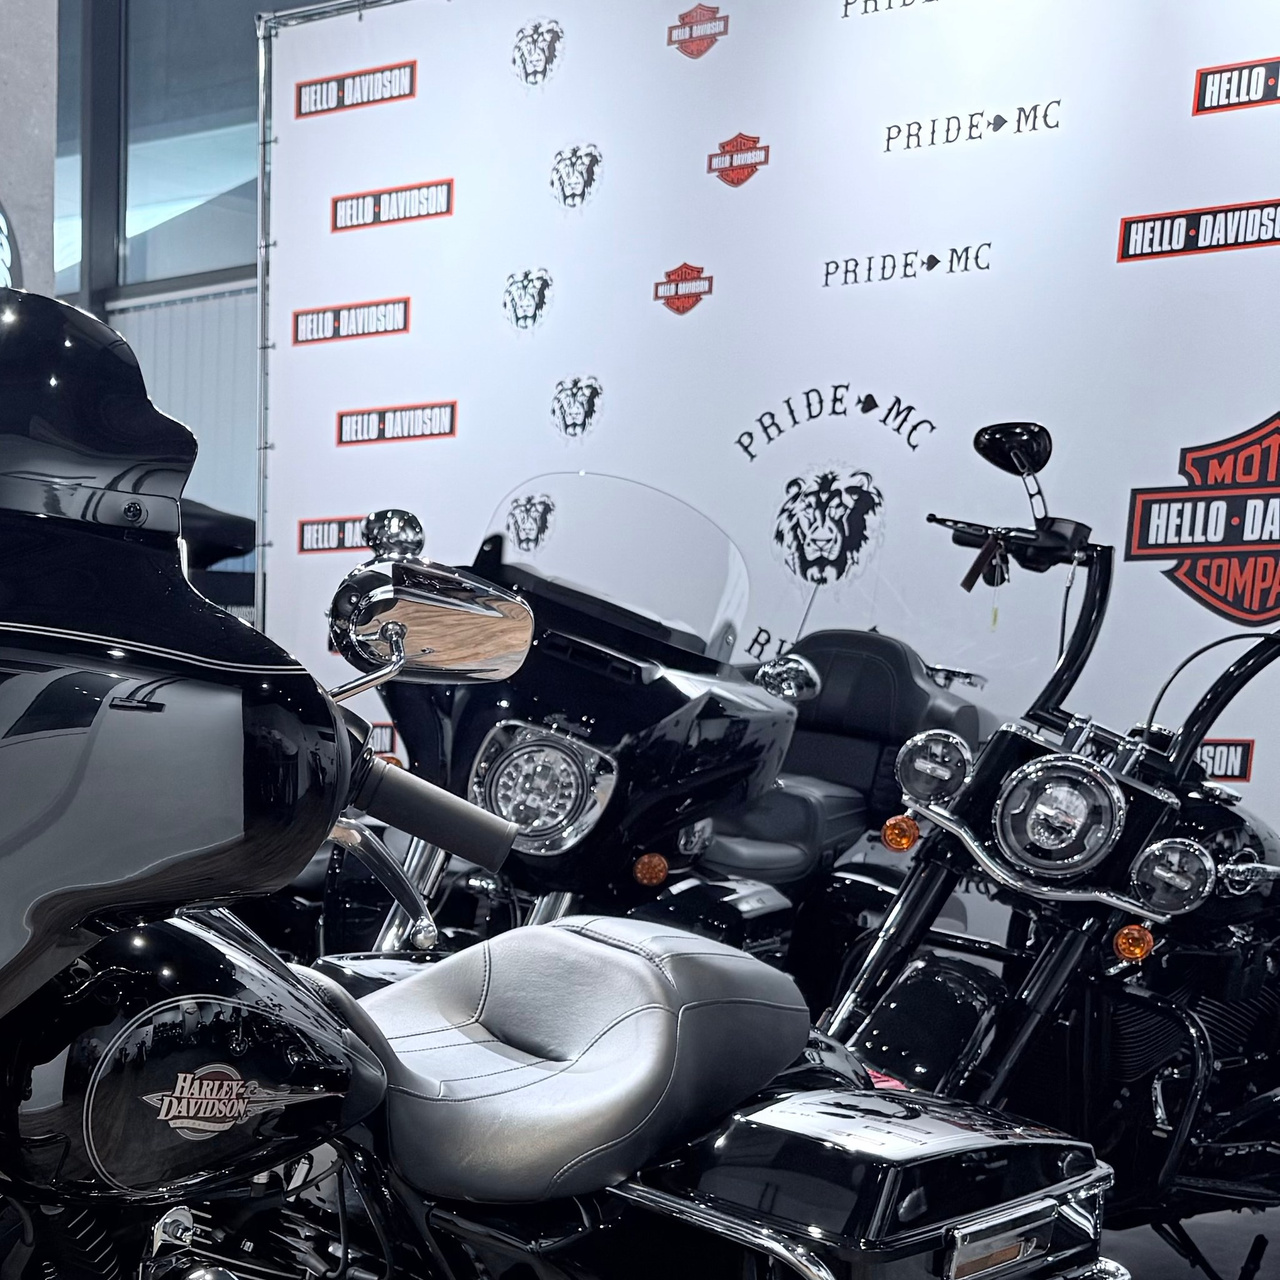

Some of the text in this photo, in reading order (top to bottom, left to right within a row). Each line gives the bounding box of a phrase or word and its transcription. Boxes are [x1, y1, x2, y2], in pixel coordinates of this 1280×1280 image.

[301, 66, 411, 113] HELLO DAVIDSON
[1204, 66, 1266, 107] HELLO
[883, 99, 1061, 152] PRIDE MC
[337, 184, 447, 228] HELLO DAVIDSON
[1129, 217, 1186, 255] HELLO
[822, 242, 992, 287] PRIDE MC
[298, 302, 405, 341] HELLO DAVIDSON
[342, 406, 451, 442] HELLO DAVIDSON
[734, 382, 936, 462] PRIDE MC
[303, 522, 338, 549] HELLO
[1148, 501, 1227, 544] HELLO
[157, 1096, 248, 1120] DAVIDSON
